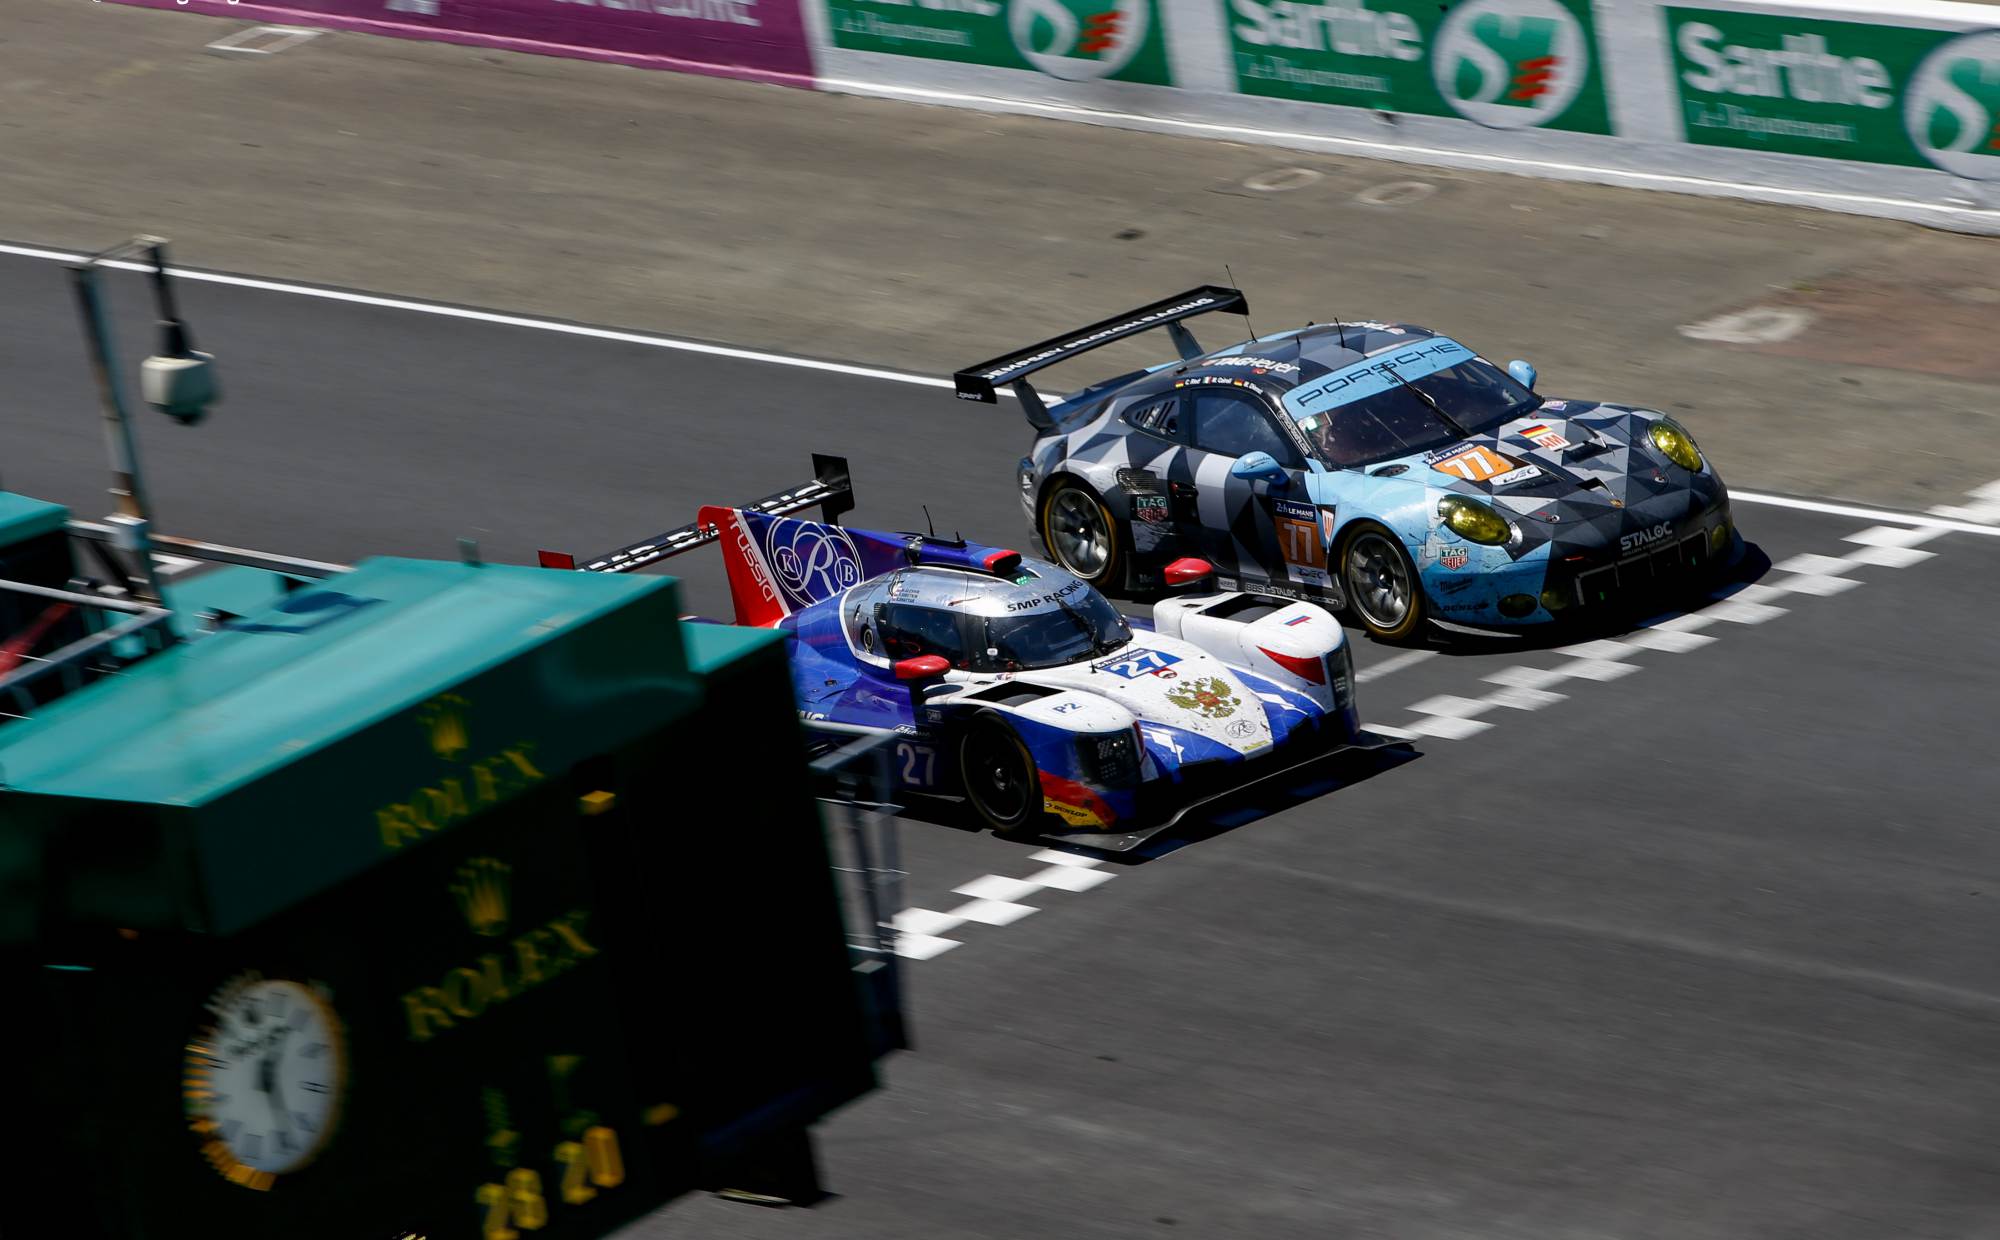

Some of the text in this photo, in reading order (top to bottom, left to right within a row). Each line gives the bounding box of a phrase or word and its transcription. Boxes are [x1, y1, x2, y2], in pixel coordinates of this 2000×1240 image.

[1677, 21, 1894, 109] Sarthe
[1296, 342, 1462, 407] PORSCHE
[1537, 434, 1566, 448] AM
[1444, 451, 1495, 480] 77
[1140, 498, 1165, 507] TAG
[1283, 522, 1313, 564] 77
[1620, 520, 1673, 551] STALOC
[729, 520, 776, 602] russia
[781, 553, 796, 574] K
[844, 564, 854, 582] B
[1442, 548, 1465, 556] TAG
[1442, 557, 1466, 569] HEUER
[1007, 579, 1084, 613] SMP RACING
[1110, 651, 1168, 678] 27
[1052, 702, 1083, 714] P2
[897, 742, 936, 786] 27
[373, 741, 546, 848] ROLEX
[400, 909, 601, 1042] ROLEX
